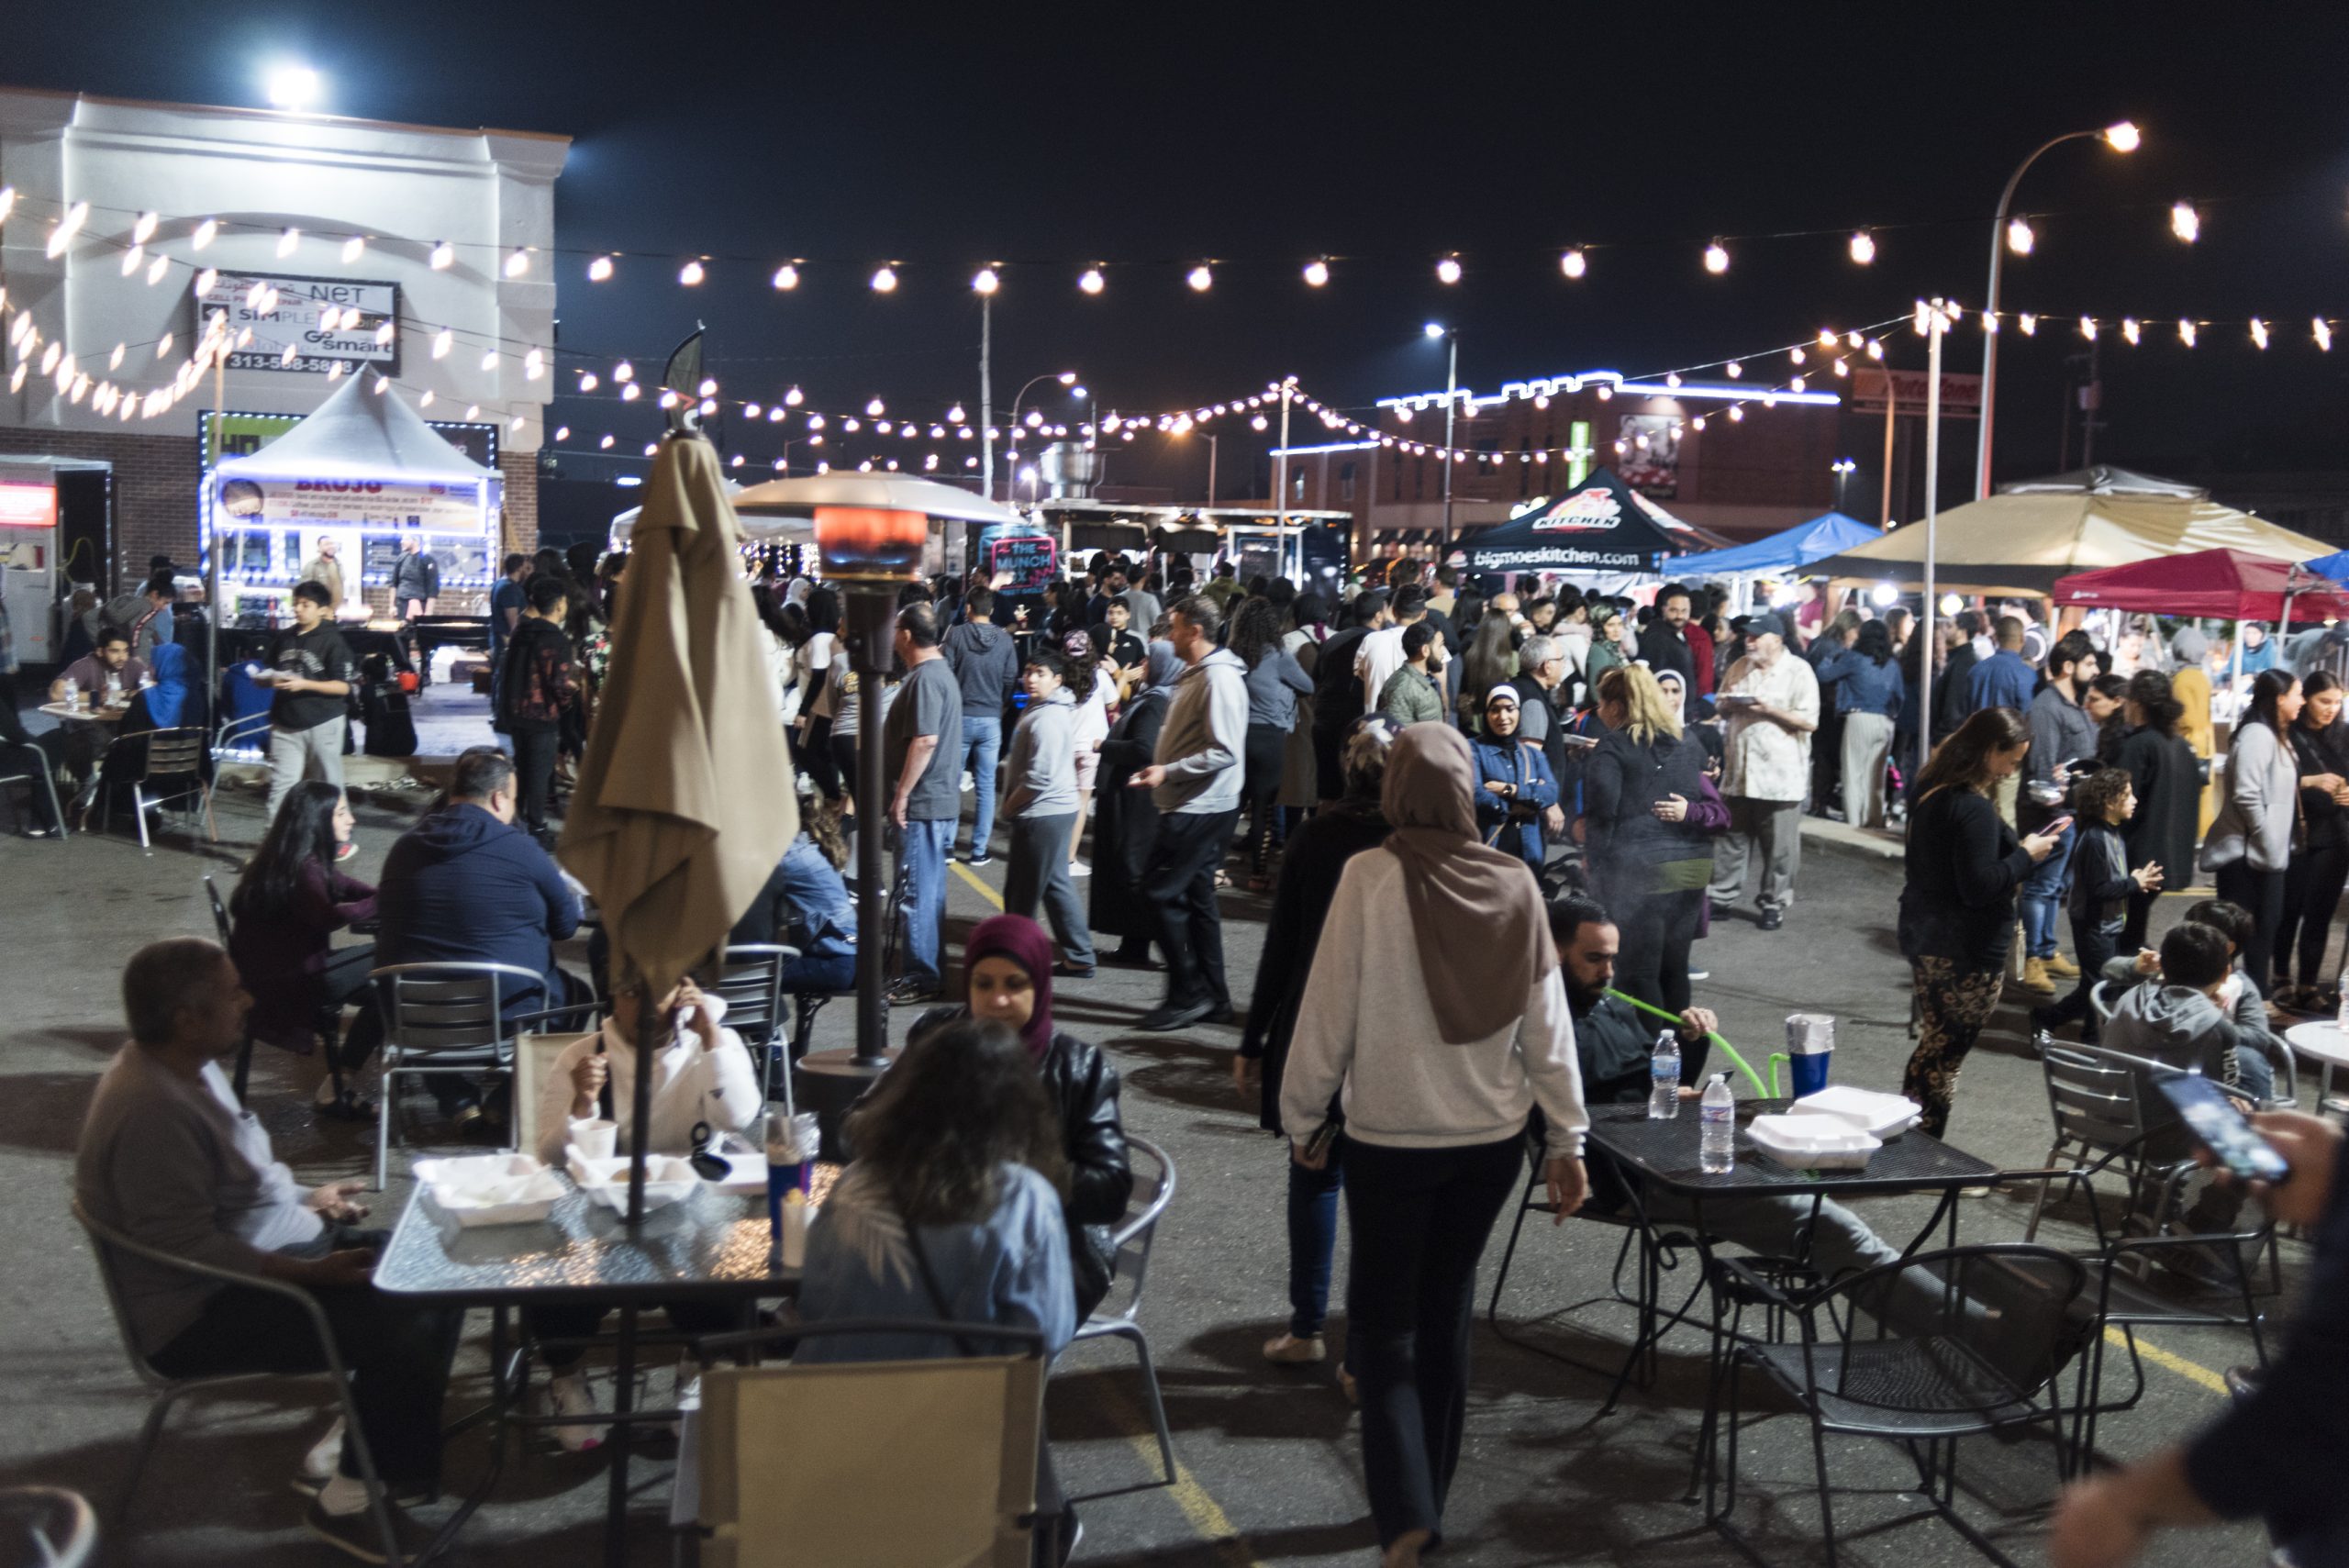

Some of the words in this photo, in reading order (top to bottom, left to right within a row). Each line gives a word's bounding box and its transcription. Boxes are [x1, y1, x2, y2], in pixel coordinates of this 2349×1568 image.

[230, 354, 353, 373] 313-58-588
[1539, 516, 1616, 526] KITCHEN
[1012, 542, 1037, 555] THE
[996, 554, 1052, 570] MUNCH
[1474, 546, 1640, 569] bigmoeskitchen.com
